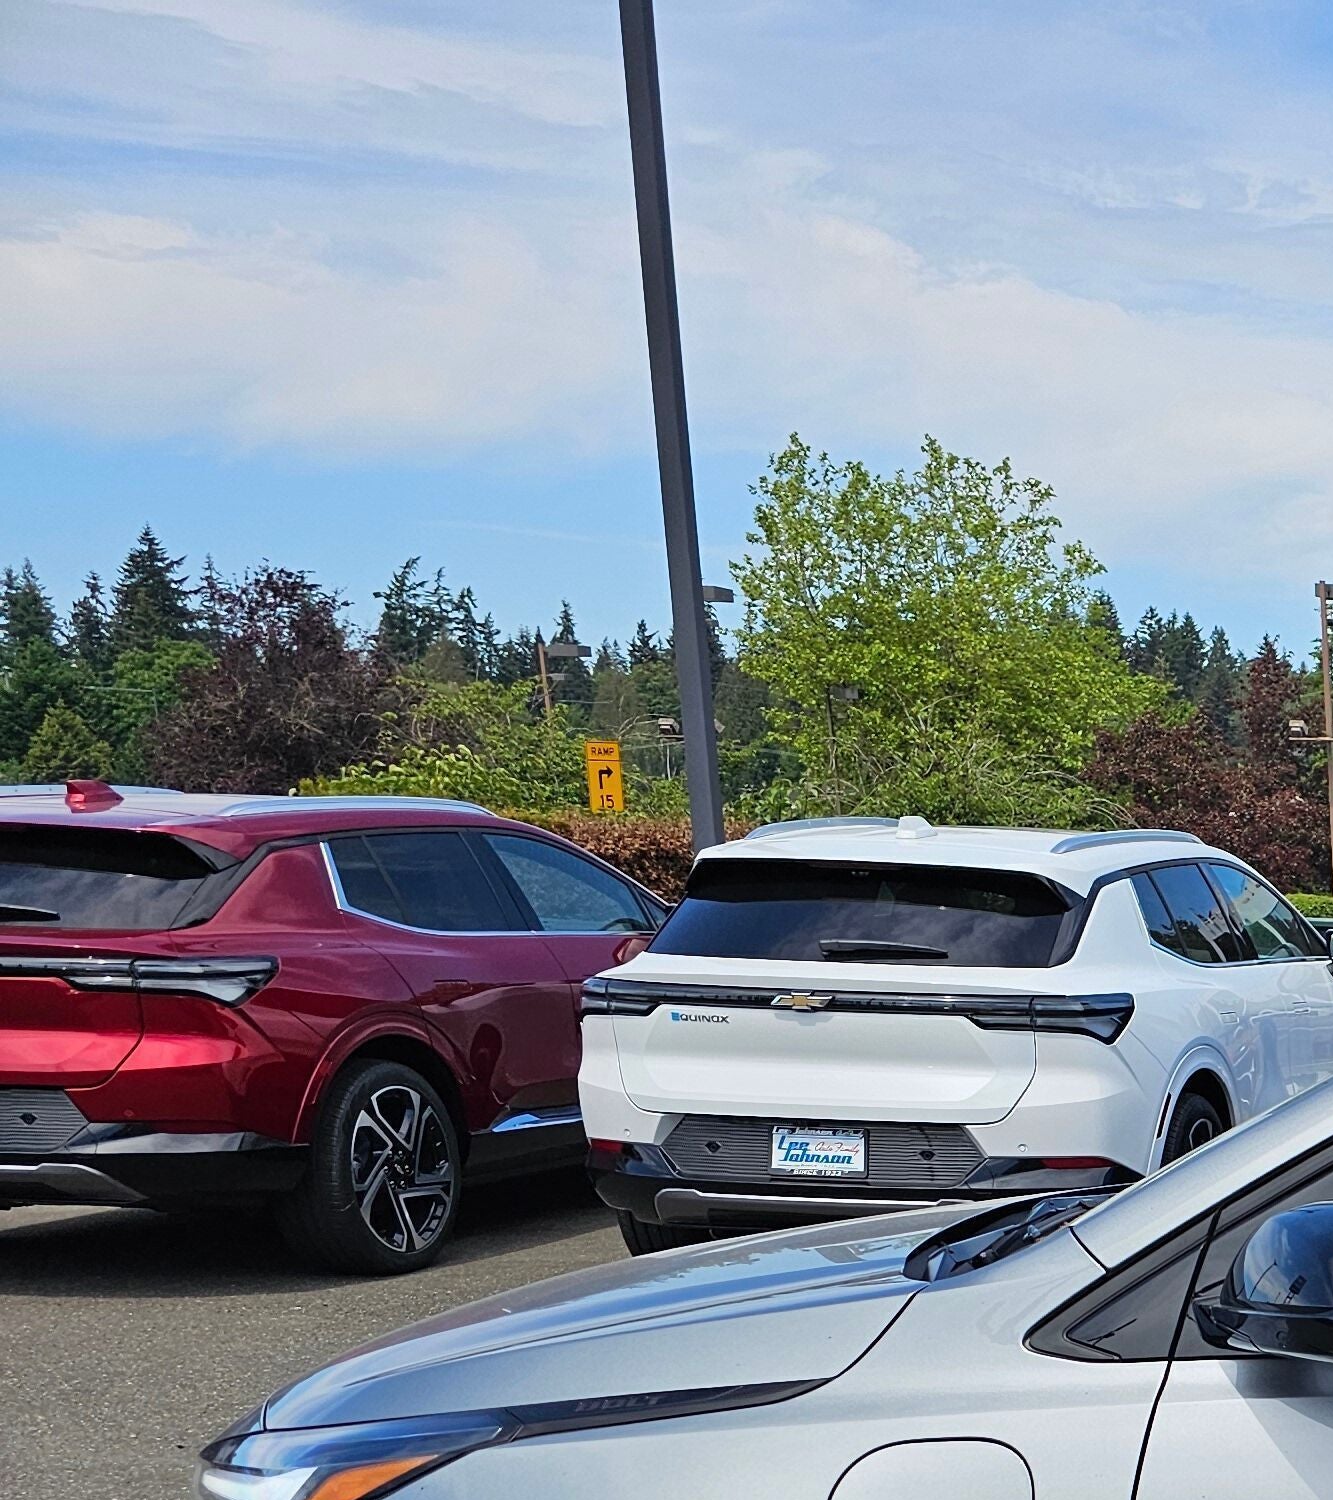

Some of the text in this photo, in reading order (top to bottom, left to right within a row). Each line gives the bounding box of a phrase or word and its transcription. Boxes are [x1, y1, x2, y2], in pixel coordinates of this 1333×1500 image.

[591, 747, 614, 755] RAMP
[600, 794, 614, 808] 15
[671, 1012, 729, 1024] EQUINOX
[778, 1135, 811, 1150] Lee
[778, 1146, 855, 1164] Johnson
